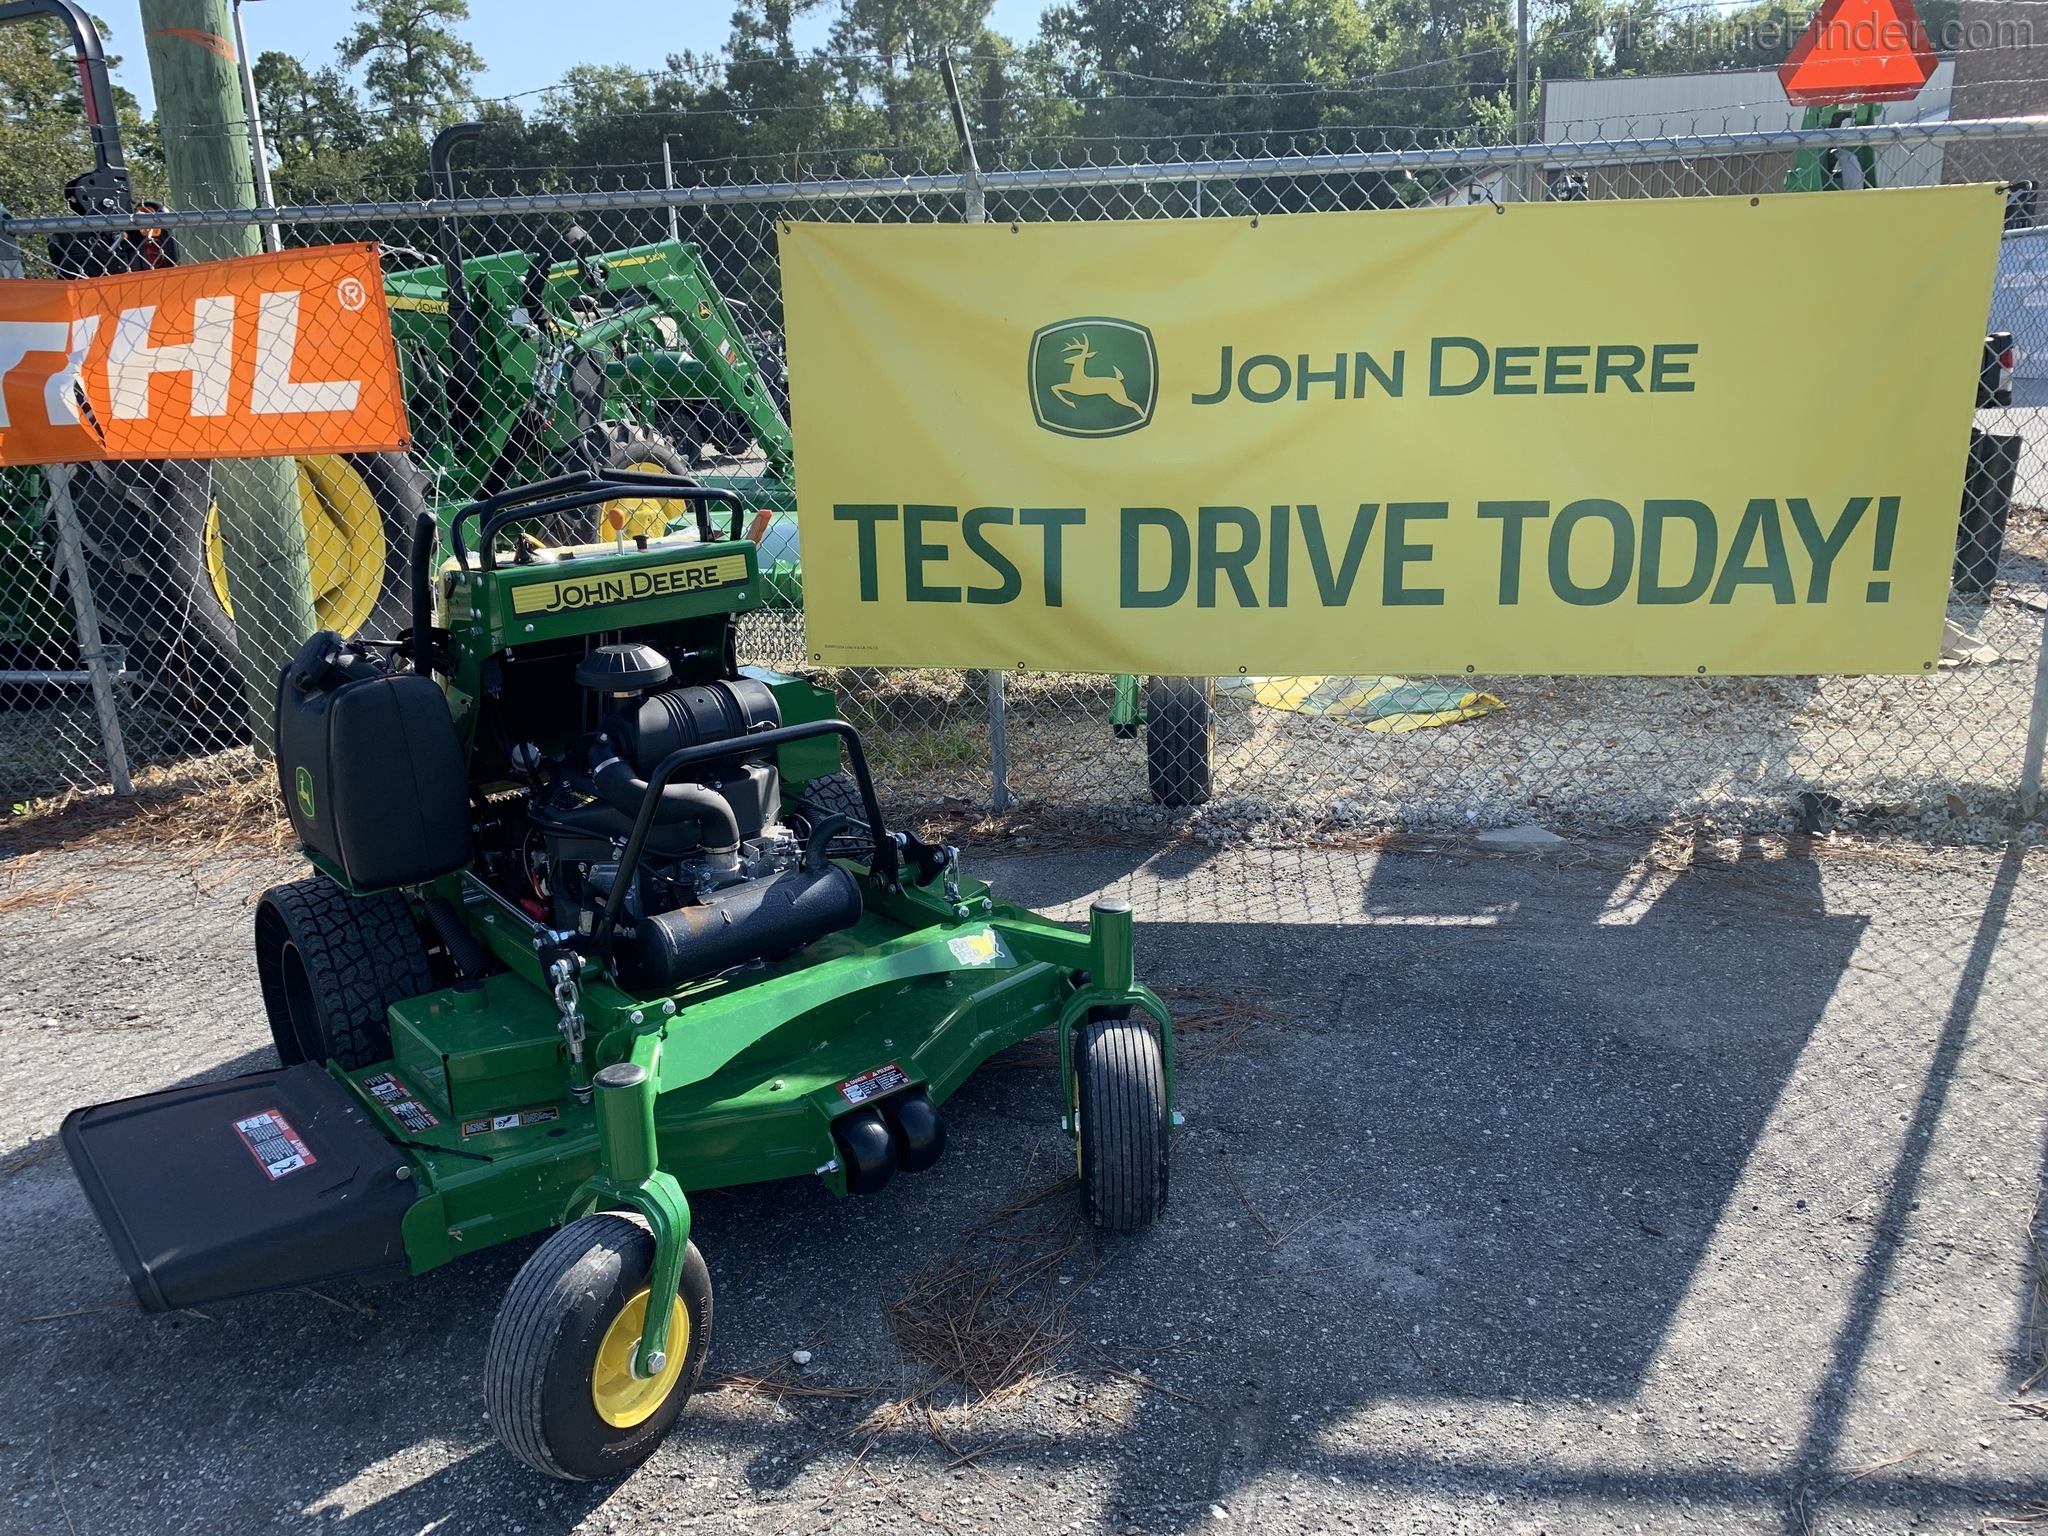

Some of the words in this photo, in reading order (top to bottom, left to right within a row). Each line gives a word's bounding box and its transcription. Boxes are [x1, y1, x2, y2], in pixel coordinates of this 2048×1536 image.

[1191, 344, 1406, 406] JOHN
[1429, 336, 1700, 397] DEERE
[833, 503, 1087, 608] TEST
[1120, 501, 1450, 608] DRIVE
[1477, 496, 1902, 606] TODAY!
[546, 579, 624, 610] JOHN
[630, 565, 720, 595] DEERE
